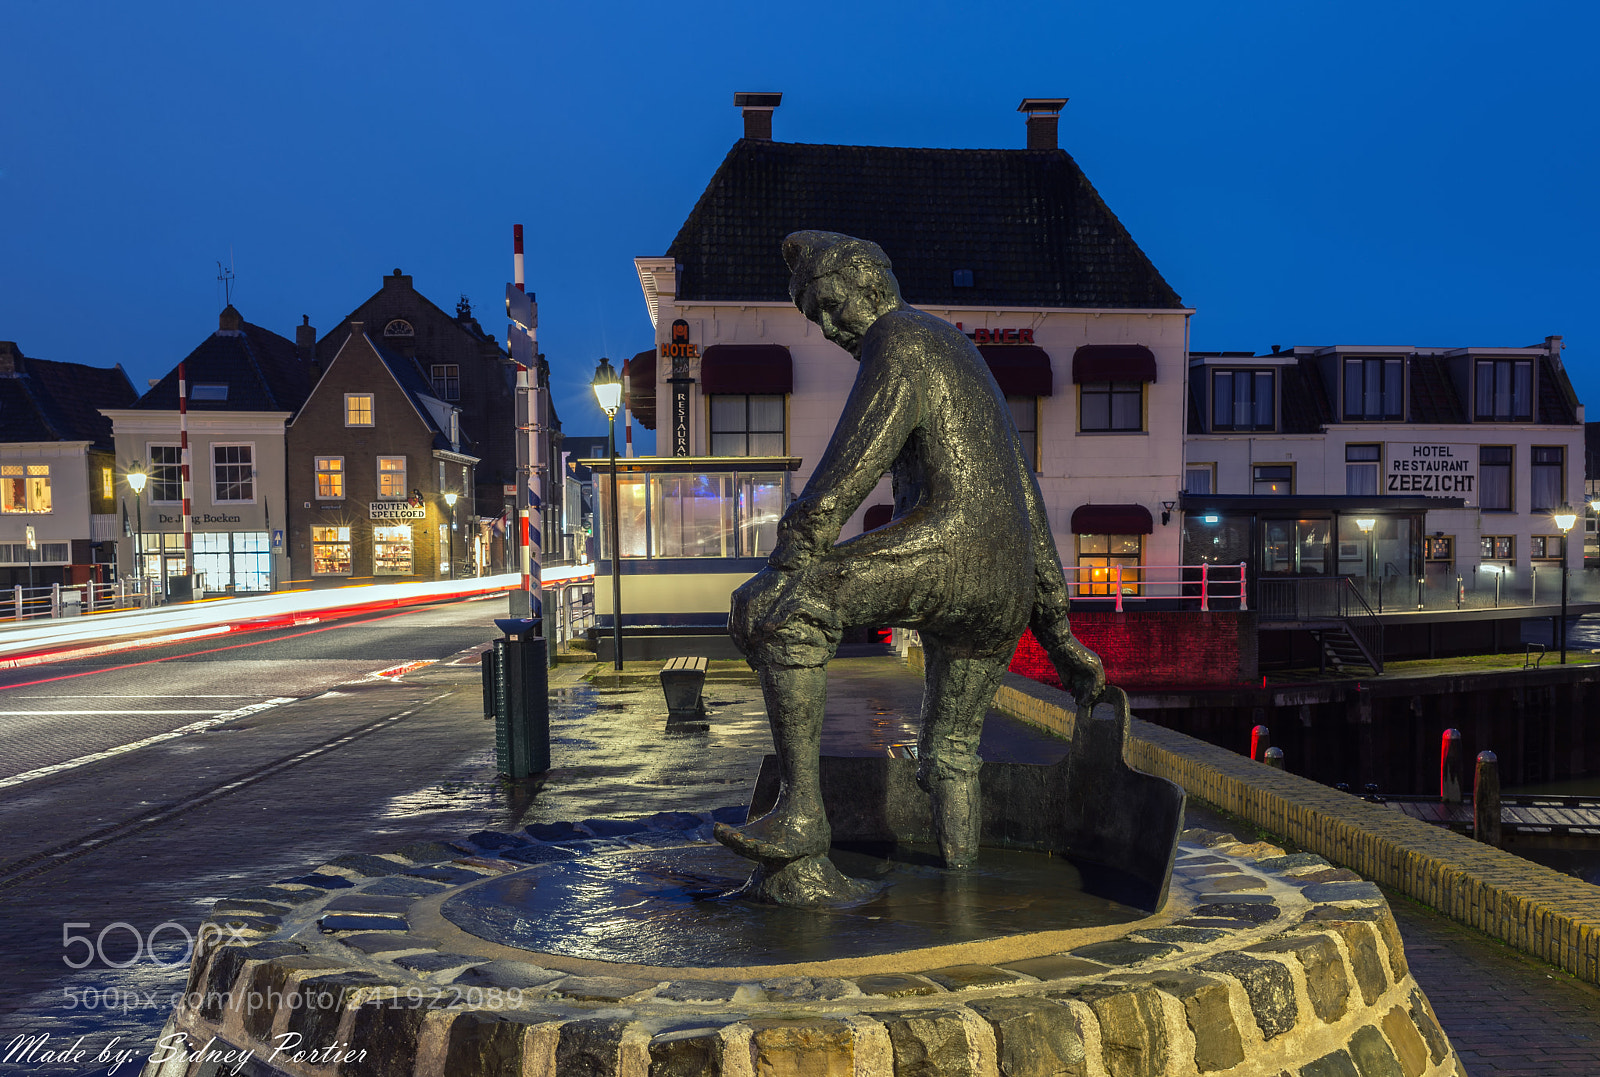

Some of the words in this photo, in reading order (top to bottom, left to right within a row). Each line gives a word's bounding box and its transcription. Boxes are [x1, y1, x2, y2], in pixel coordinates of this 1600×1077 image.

[975, 328, 1034, 344] BIER
[661, 343, 701, 358] HOTEL
[1413, 446, 1454, 457] HOTEL
[1393, 460, 1470, 472] RESTAURANT
[1388, 474, 1475, 492] ZEEZICHT
[371, 503, 409, 511] HOUTEN
[158, 514, 173, 524] De
[175, 513, 201, 525] Jg
[203, 513, 241, 523] Boeken
